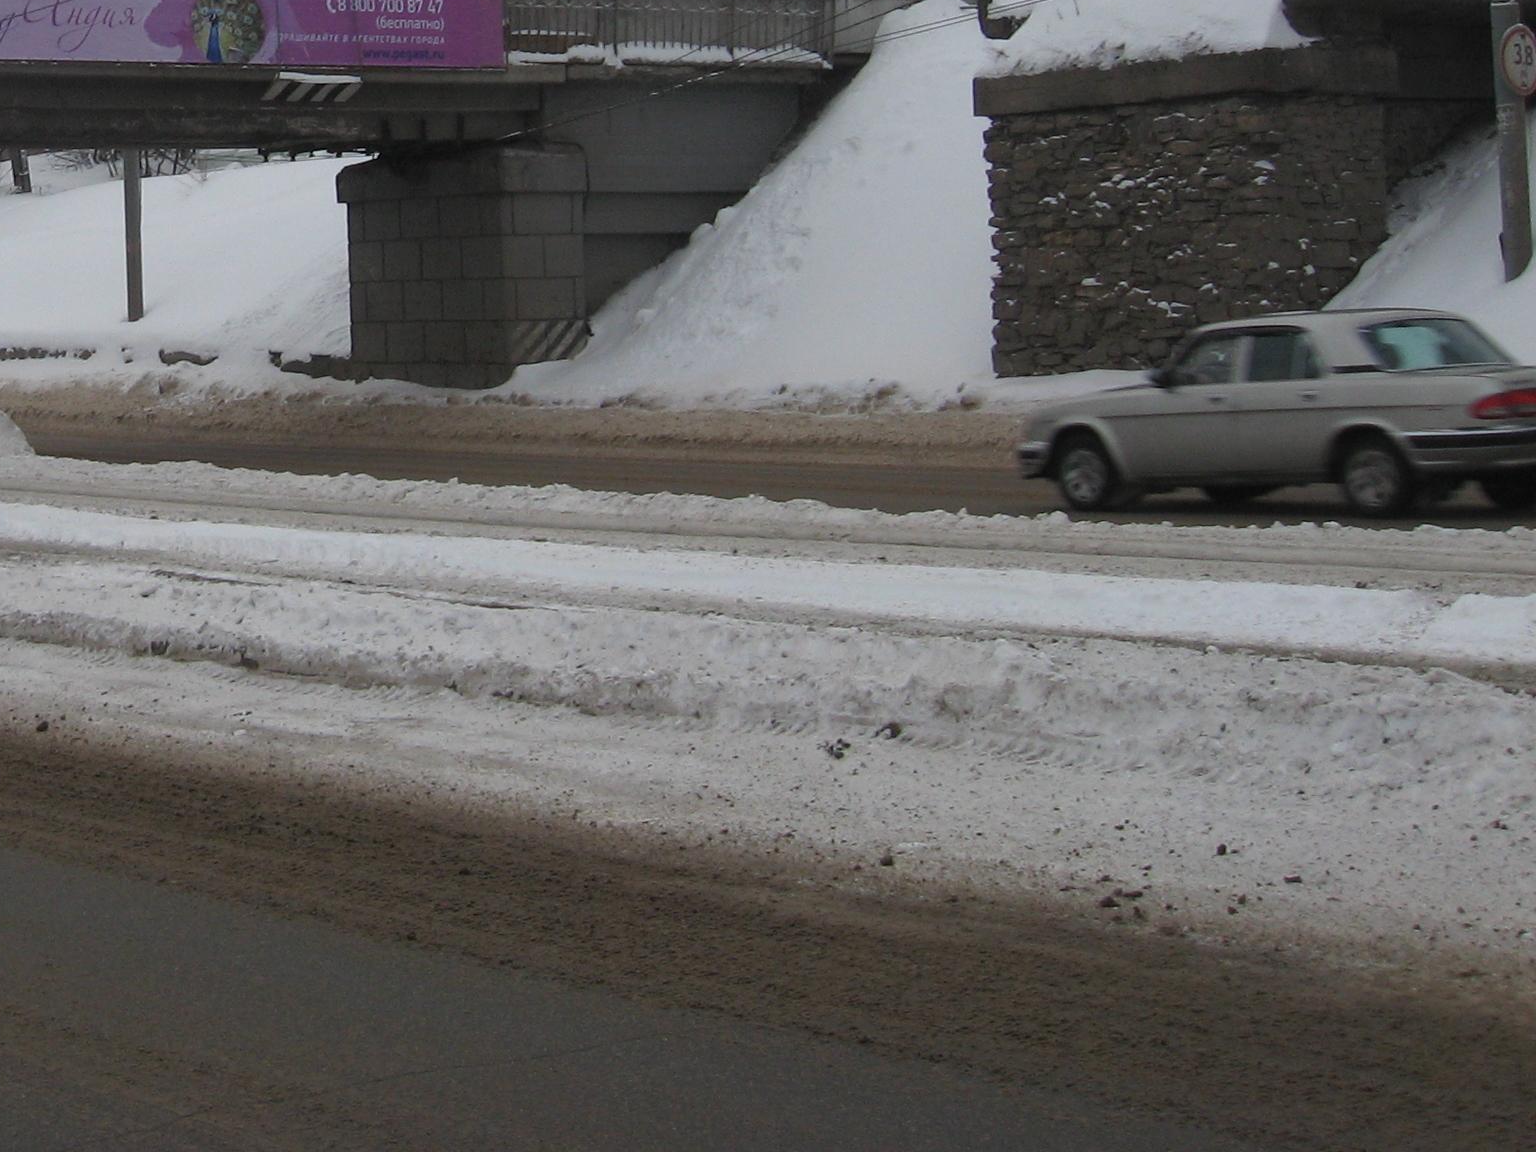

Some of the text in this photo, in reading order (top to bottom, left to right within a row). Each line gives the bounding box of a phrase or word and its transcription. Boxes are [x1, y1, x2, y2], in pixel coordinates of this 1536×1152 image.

[407, 0, 422, 13] 87
[427, 0, 443, 14] 47
[376, 16, 445, 31] (бесплатно)
[411, 35, 445, 45] ГОРОДА
